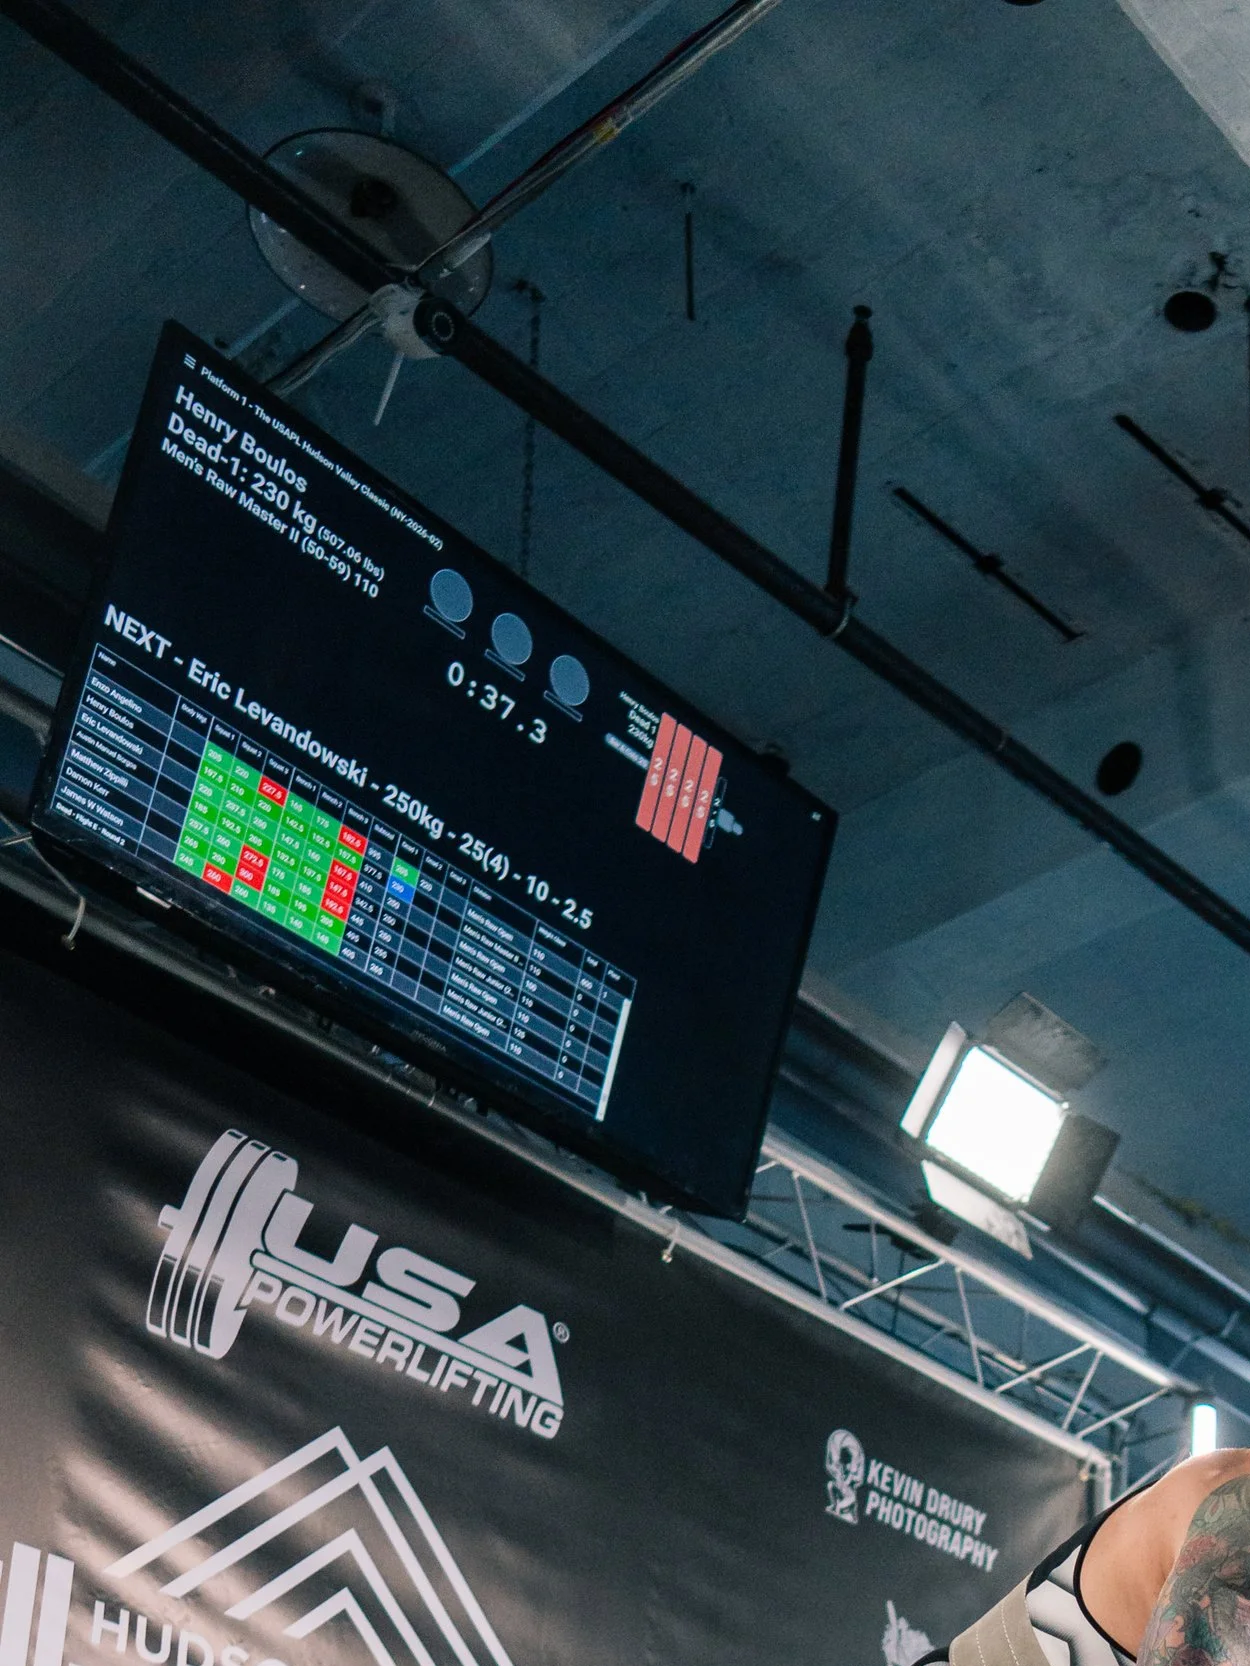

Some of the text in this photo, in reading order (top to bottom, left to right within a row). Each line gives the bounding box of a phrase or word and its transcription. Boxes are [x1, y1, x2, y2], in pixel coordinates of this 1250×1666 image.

[175, 385, 306, 492] Henry Boulos
[200, 365, 240, 401] Platform
[241, 395, 247, 406] 1
[254, 404, 271, 423] The
[271, 418, 301, 446] USAPL
[301, 440, 334, 470] Hudson
[335, 464, 360, 490] Valley
[360, 484, 390, 511] Classic
[161, 437, 379, 598] Men's Raw Master II (50-59) 110
[168, 412, 384, 581] Dead-1: 230 kg (507.06 lbs)
[80, 712, 96, 727] Eric
[85, 694, 109, 714] Henry
[90, 676, 111, 693] Enzo
[447, 662, 546, 743] 0:37.3
[60, 785, 86, 805] James
[65, 766, 93, 787] Damon
[92, 782, 110, 796] Kerr
[70, 748, 104, 772] Matthew
[104, 604, 171, 657] NEXT
[188, 658, 230, 699] Eric
[235, 688, 367, 786] Levandowski
[383, 784, 443, 839] 250kg
[459, 832, 509, 880] 25(4)
[527, 875, 549, 901] 10
[562, 898, 593, 929] 2.5
[264, 1189, 564, 1406] USA
[241, 1270, 565, 1440] POWERLIFTING
[865, 1490, 1000, 1573] PHOTOGRAPHY
[867, 1458, 987, 1536] KEVIN DRURY
